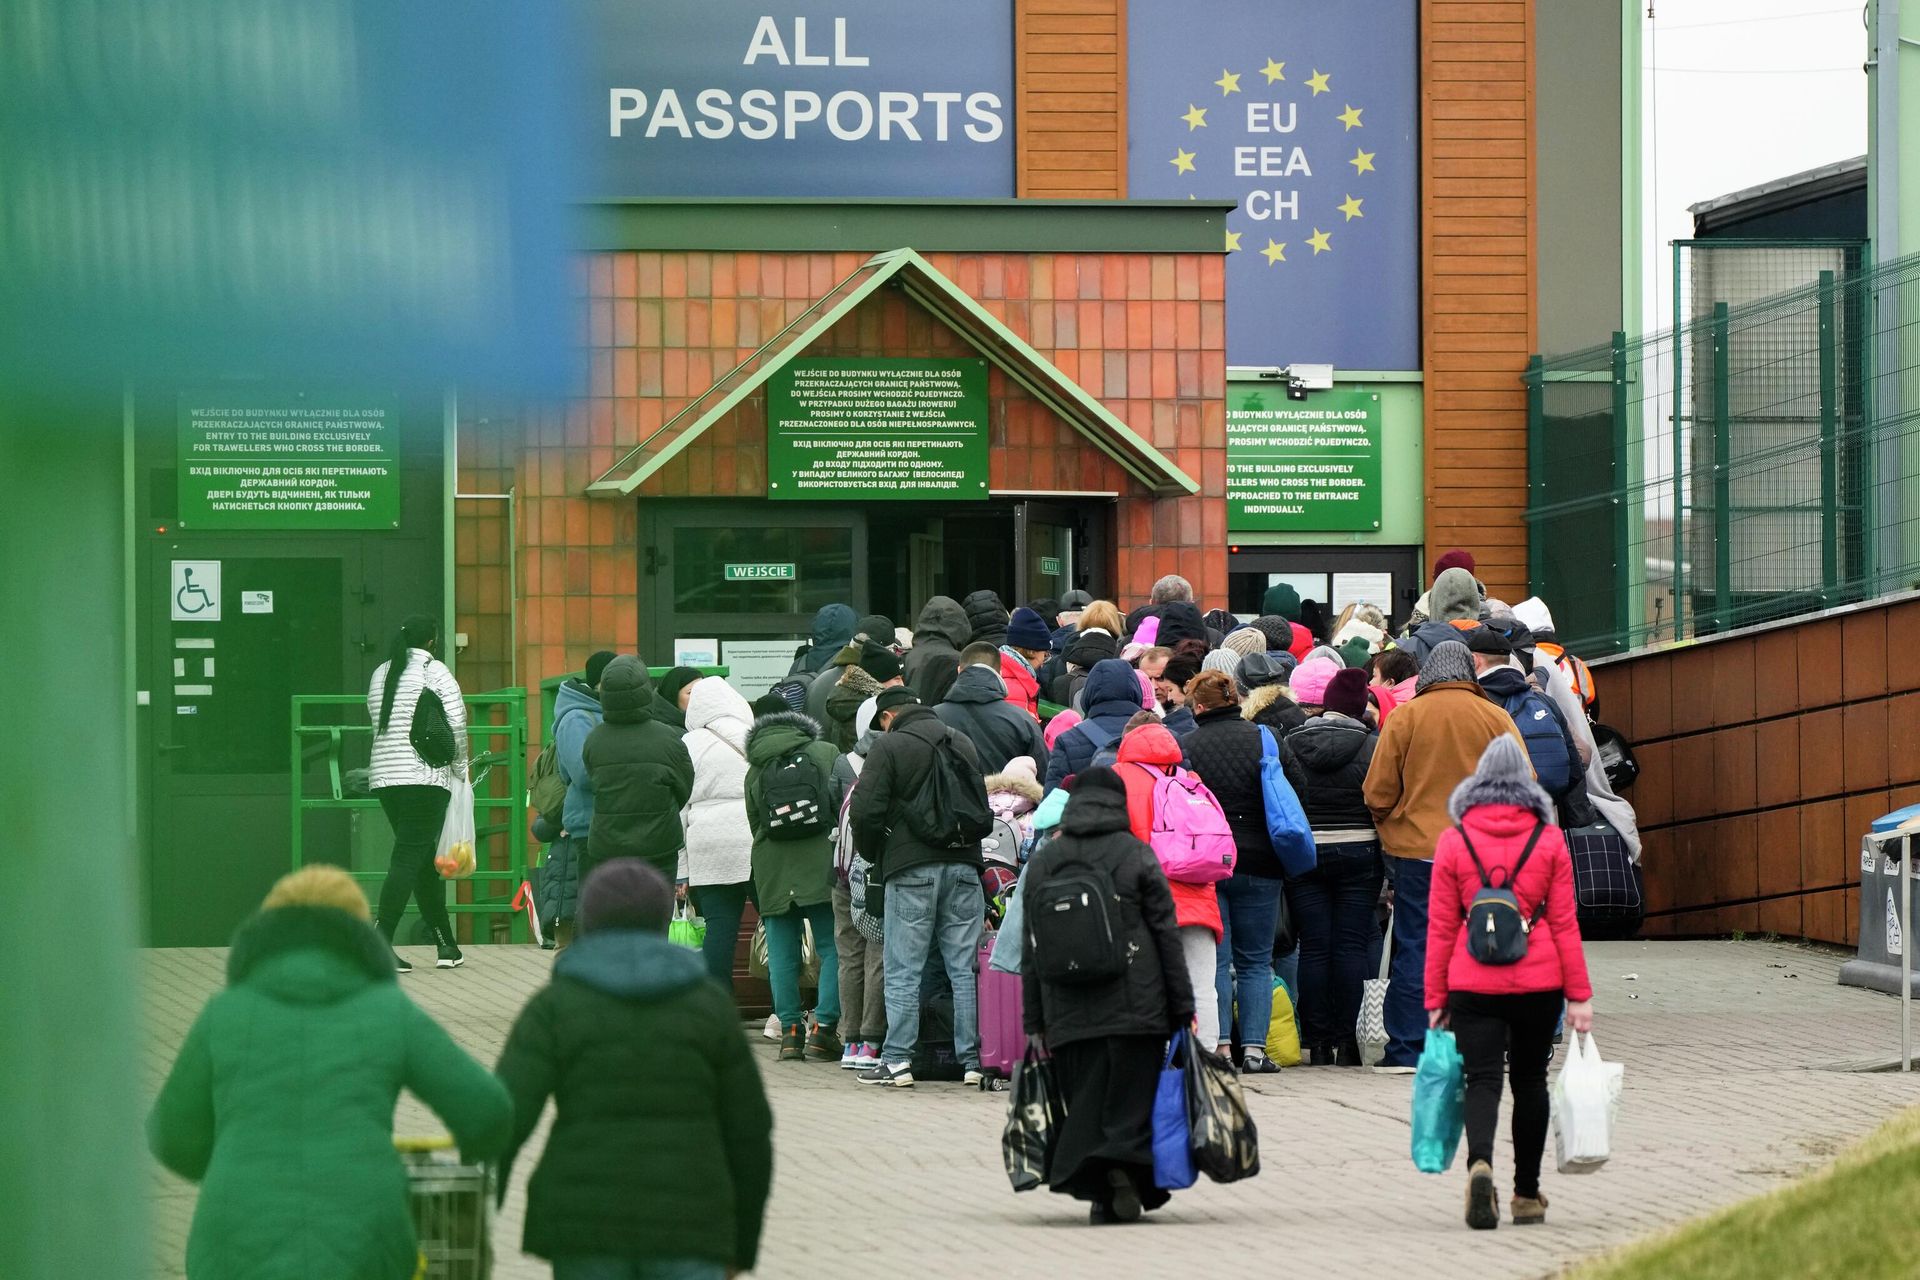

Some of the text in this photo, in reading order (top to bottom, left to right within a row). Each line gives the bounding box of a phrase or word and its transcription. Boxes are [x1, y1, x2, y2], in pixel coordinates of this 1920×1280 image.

[742, 16, 870, 68] ALL
[609, 87, 1004, 144] PASSPORTS
[1246, 103, 1298, 134] EU
[1234, 146, 1312, 177] EEA
[1245, 190, 1300, 222] CH
[794, 368, 827, 377] WEJŚCIE
[879, 370, 923, 379] WYŁĄCZNIE
[941, 368, 961, 377] OSÓB
[795, 378, 961, 389] PRZEKRACZAJĄCYCH GRANICĘ PAŃSTWOWĄ.
[803, 388, 836, 397] WEJŚCIA
[873, 388, 913, 397] WCHODZIĆ
[855, 398, 884, 407] DUŻEGO
[886, 398, 916, 407] BAGAŻU
[289, 409, 340, 418] WYŁĄCZNIE
[912, 409, 946, 417] WEJŚCIA
[1275, 411, 1324, 420] WYŁĄCZNIE
[1344, 409, 1367, 418] OSÓB
[192, 419, 384, 430] PRZEKRACZAJĄCYCH GRANICĘ PAŃSTWOWĄ.
[867, 419, 887, 427] OSÓB
[1270, 425, 1307, 434] GRANICĘ
[1309, 423, 1366, 434] PAŃSTWOWĄ.
[1268, 436, 1312, 445] WCHODZIĆ
[836, 449, 920, 459] ДЕРЖАВНИЙ КОРДОН.
[813, 461, 824, 469] ДО
[826, 461, 850, 469] ВХОДУ
[852, 461, 897, 469] ПІДХОДИТИ
[910, 461, 944, 469] ОДНОМУ.
[190, 468, 211, 477] ВХІД
[262, 468, 281, 477] ДЛЯ
[799, 471, 835, 479] ВИПАДКУ
[240, 477, 337, 488] ДЕРЖАВНИЙ КОРДОН.
[879, 481, 897, 489] ВХІД
[900, 481, 916, 489] ДЛЯ
[918, 481, 959, 489] ІНВАЛІДІВ.
[207, 491, 234, 500] ДВЕРІ
[236, 491, 270, 500] БУДУТЬ
[272, 491, 323, 500] ВІДЧИНЕНІ,
[315, 503, 365, 512] ДЗВОНИКА.
[733, 566, 787, 577] WEJŚCIE
